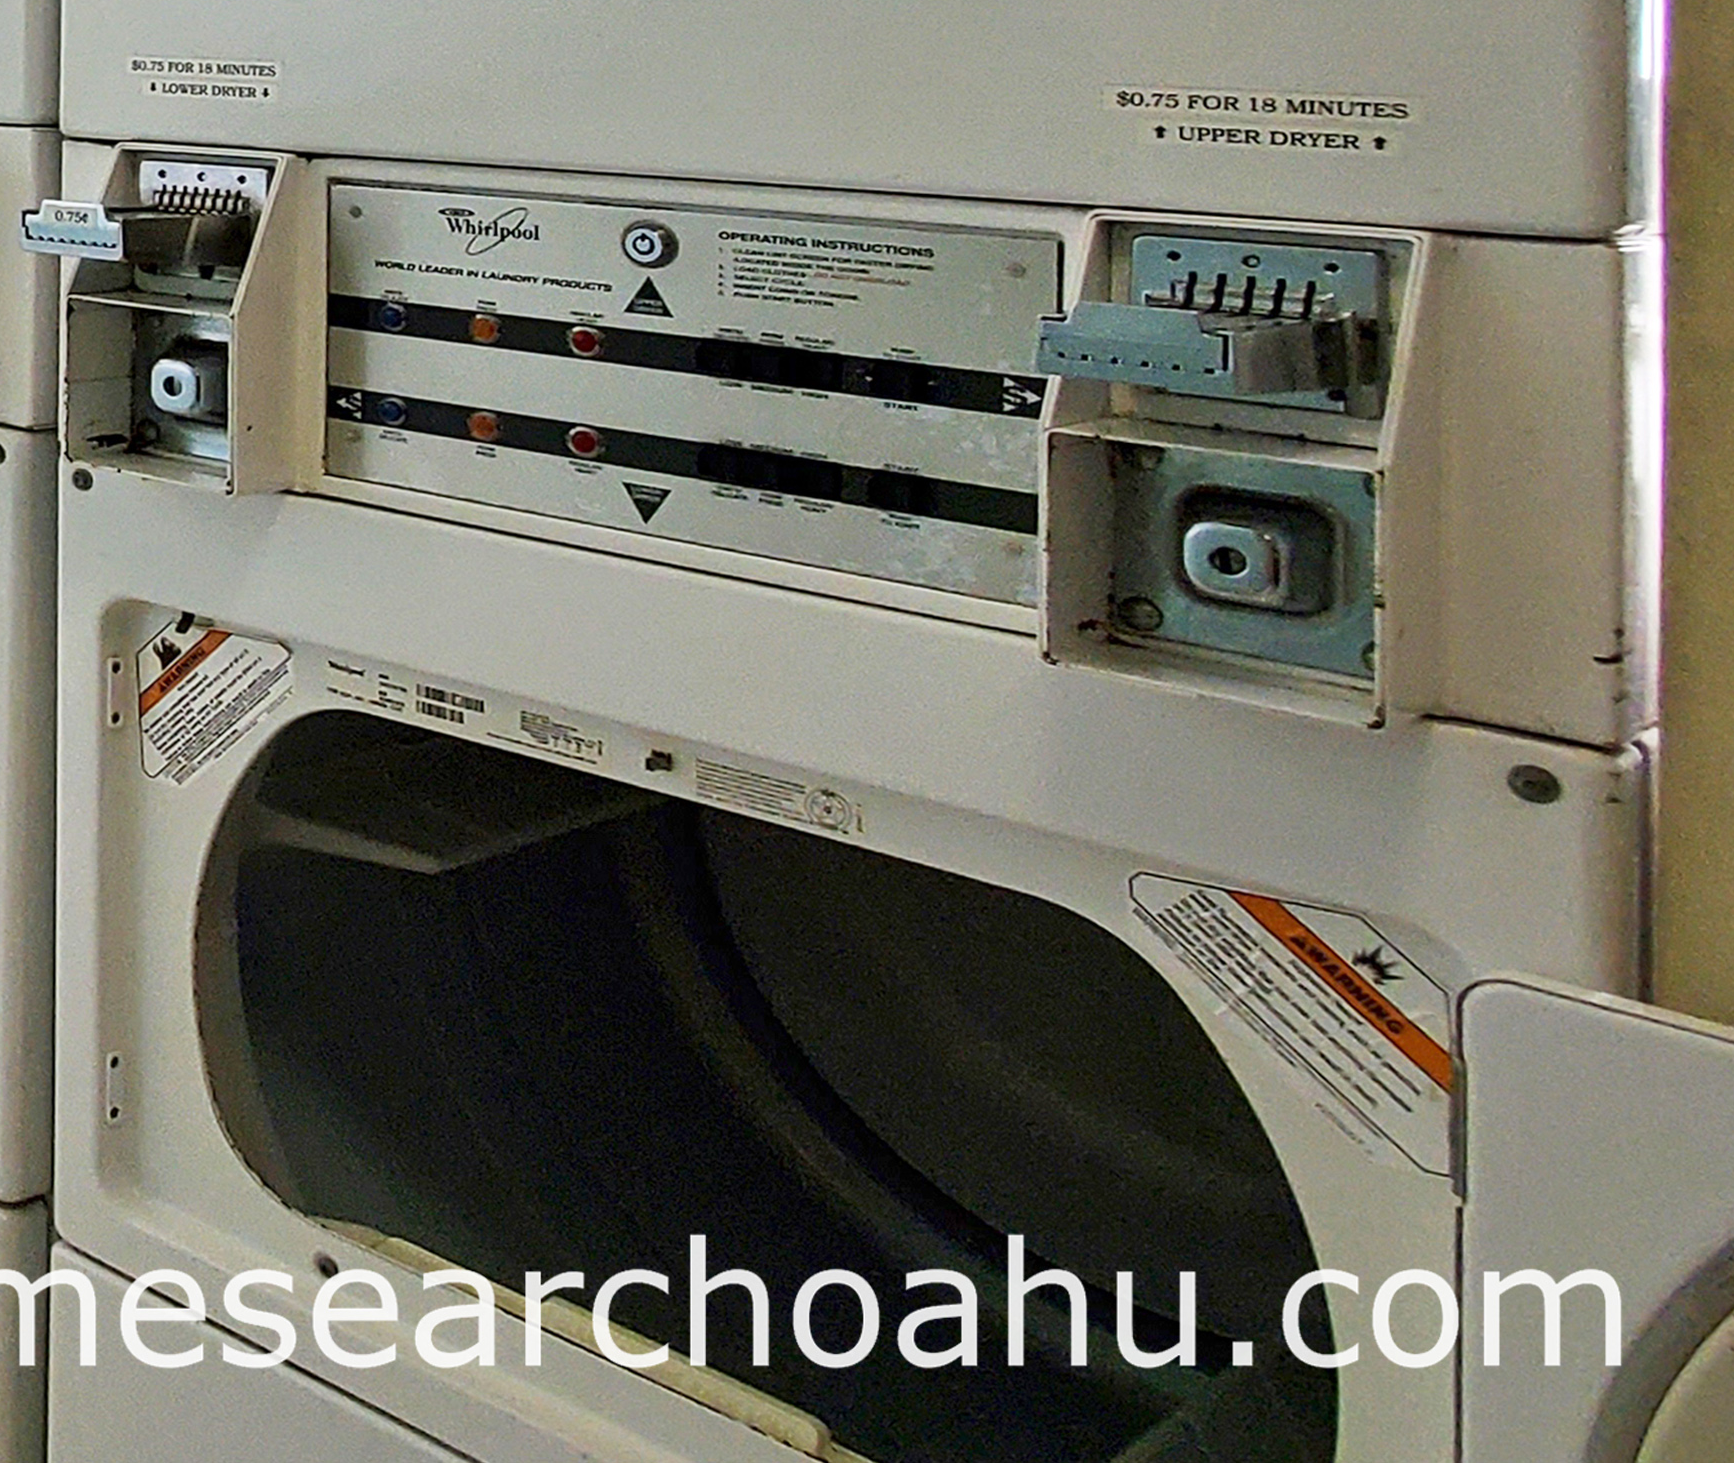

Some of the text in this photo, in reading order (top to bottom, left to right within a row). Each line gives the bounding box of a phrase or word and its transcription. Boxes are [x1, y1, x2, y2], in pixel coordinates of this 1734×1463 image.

[132, 60, 277, 77] $0.75 FOR 18 MINUTES
[162, 83, 257, 98] LOWER DRYER
[1116, 90, 1410, 119] $0.75 FOR 18 MINUTES
[1178, 125, 1361, 150] UPPER DRYER
[445, 217, 540, 242] Whirlpool
[718, 231, 934, 258] OPERATING INSTRUCTIONS
[374, 260, 613, 292] WORLD LEADER IN LAUNDRY PRODUCTS
[1307, 944, 1404, 1035] WARNING
